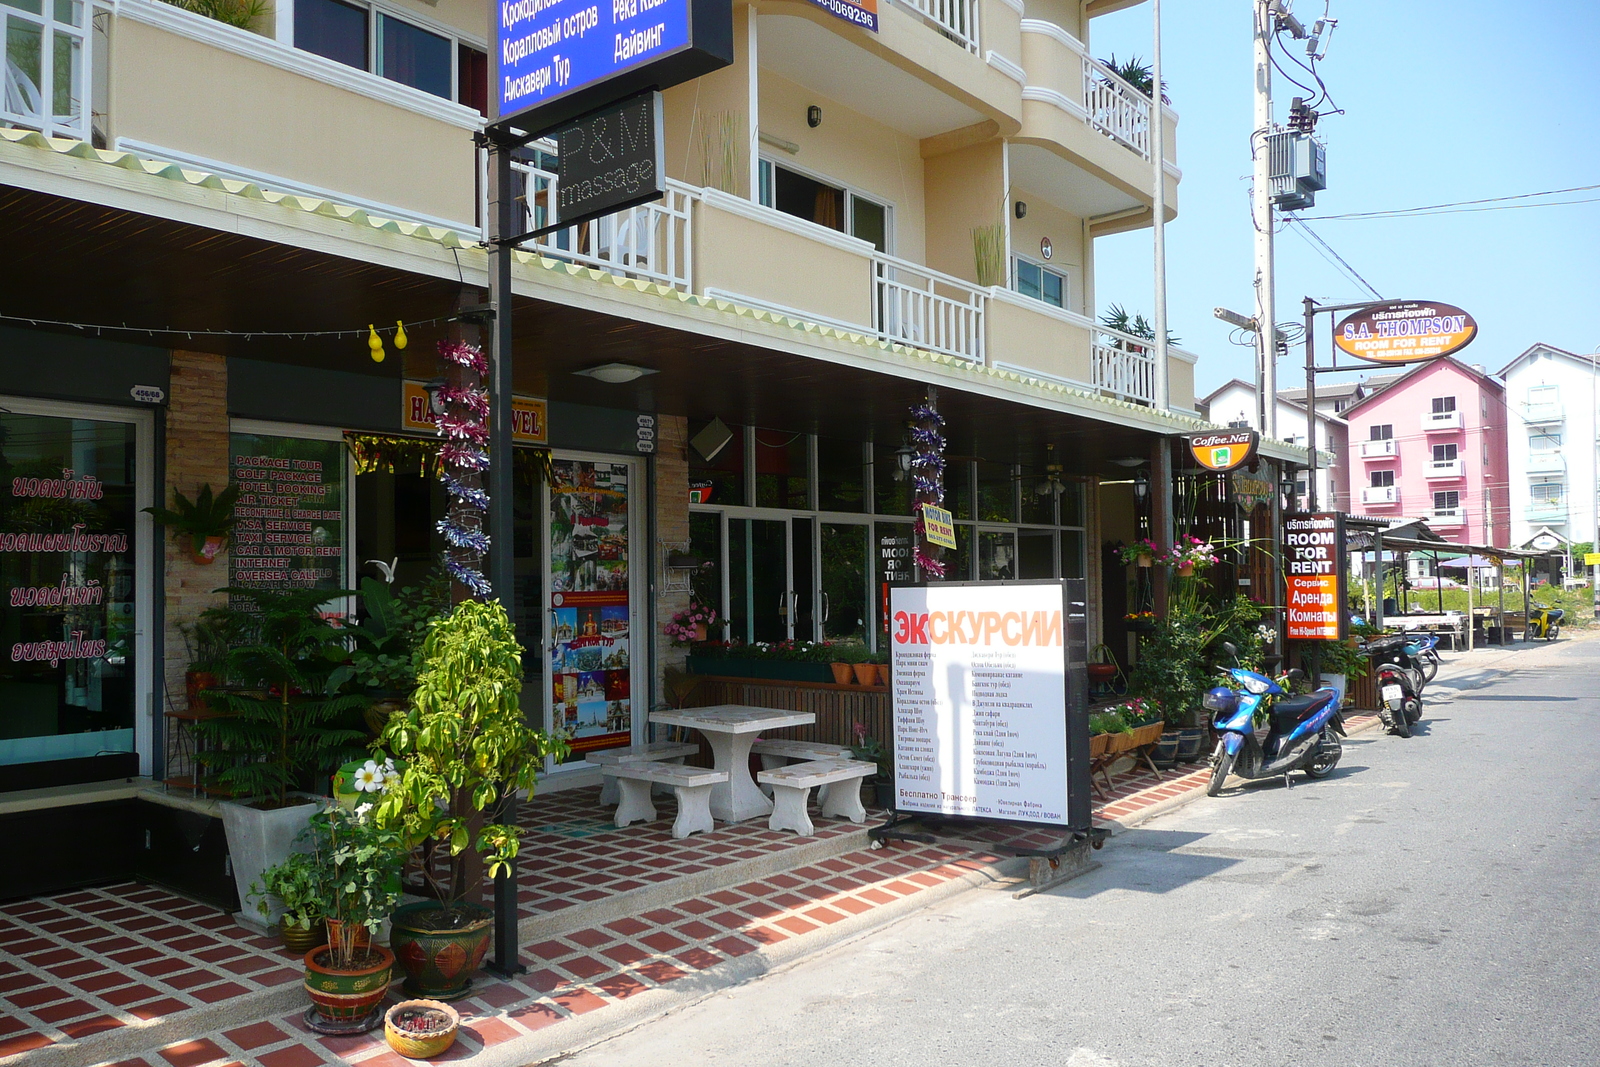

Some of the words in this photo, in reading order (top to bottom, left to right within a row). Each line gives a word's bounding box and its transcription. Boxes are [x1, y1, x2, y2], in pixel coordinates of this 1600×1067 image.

[504, 18, 561, 67] Коралловый
[564, 6, 598, 38] остров
[614, 23, 665, 63] Дайвинг
[504, 64, 551, 103] Дискавери
[554, 54, 570, 86] Тур
[561, 159, 653, 207] massage
[1344, 322, 1372, 340] S.A.
[1376, 316, 1466, 338] THOMPSON
[1355, 341, 1388, 350] ROOM
[1393, 338, 1416, 348] FOR
[1420, 336, 1452, 346] RENT
[1192, 432, 1250, 446] Coffee.Net
[236, 456, 289, 468] PACKAGE
[294, 460, 322, 471] TOUR
[236, 468, 266, 479] GOLF
[271, 471, 322, 482] PACKAGE
[12, 468, 104, 500] นวดน้ำมัน
[238, 482, 272, 492] HOTEL
[277, 484, 325, 495] BOOKING
[236, 494, 255, 504] AIR
[261, 496, 299, 506] TICKET
[286, 509, 290, 518] &
[324, 510, 341, 520] DATE
[236, 520, 262, 530] VISA
[266, 521, 312, 532] SERVICE
[928, 522, 938, 532] FOR
[940, 526, 952, 537] RENT
[236, 533, 262, 542] TAXI
[266, 534, 312, 544] SERVICE
[1288, 532, 1334, 546] ROOM
[236, 546, 260, 556] CAR
[263, 546, 270, 555] &
[274, 546, 312, 556] MOTOR
[316, 546, 342, 556] RENT
[1296, 546, 1327, 560] FOR
[236, 558, 290, 568] INTERNET
[1291, 560, 1332, 574] RENT
[236, 571, 288, 581] OVERSEA
[291, 572, 319, 581] CALL
[1294, 578, 1328, 588] Сервис
[10, 573, 103, 606] นวดฝ่าเท้า
[283, 580, 316, 588] SHOW
[1292, 590, 1332, 606] Аренда
[1289, 608, 1336, 622] Комнаты
[894, 610, 1062, 646] ЭКСКУРСИИ
[896, 660, 906, 668] Парк
[900, 789, 938, 800] Бесплатно
[941, 792, 976, 804] Трансфер
